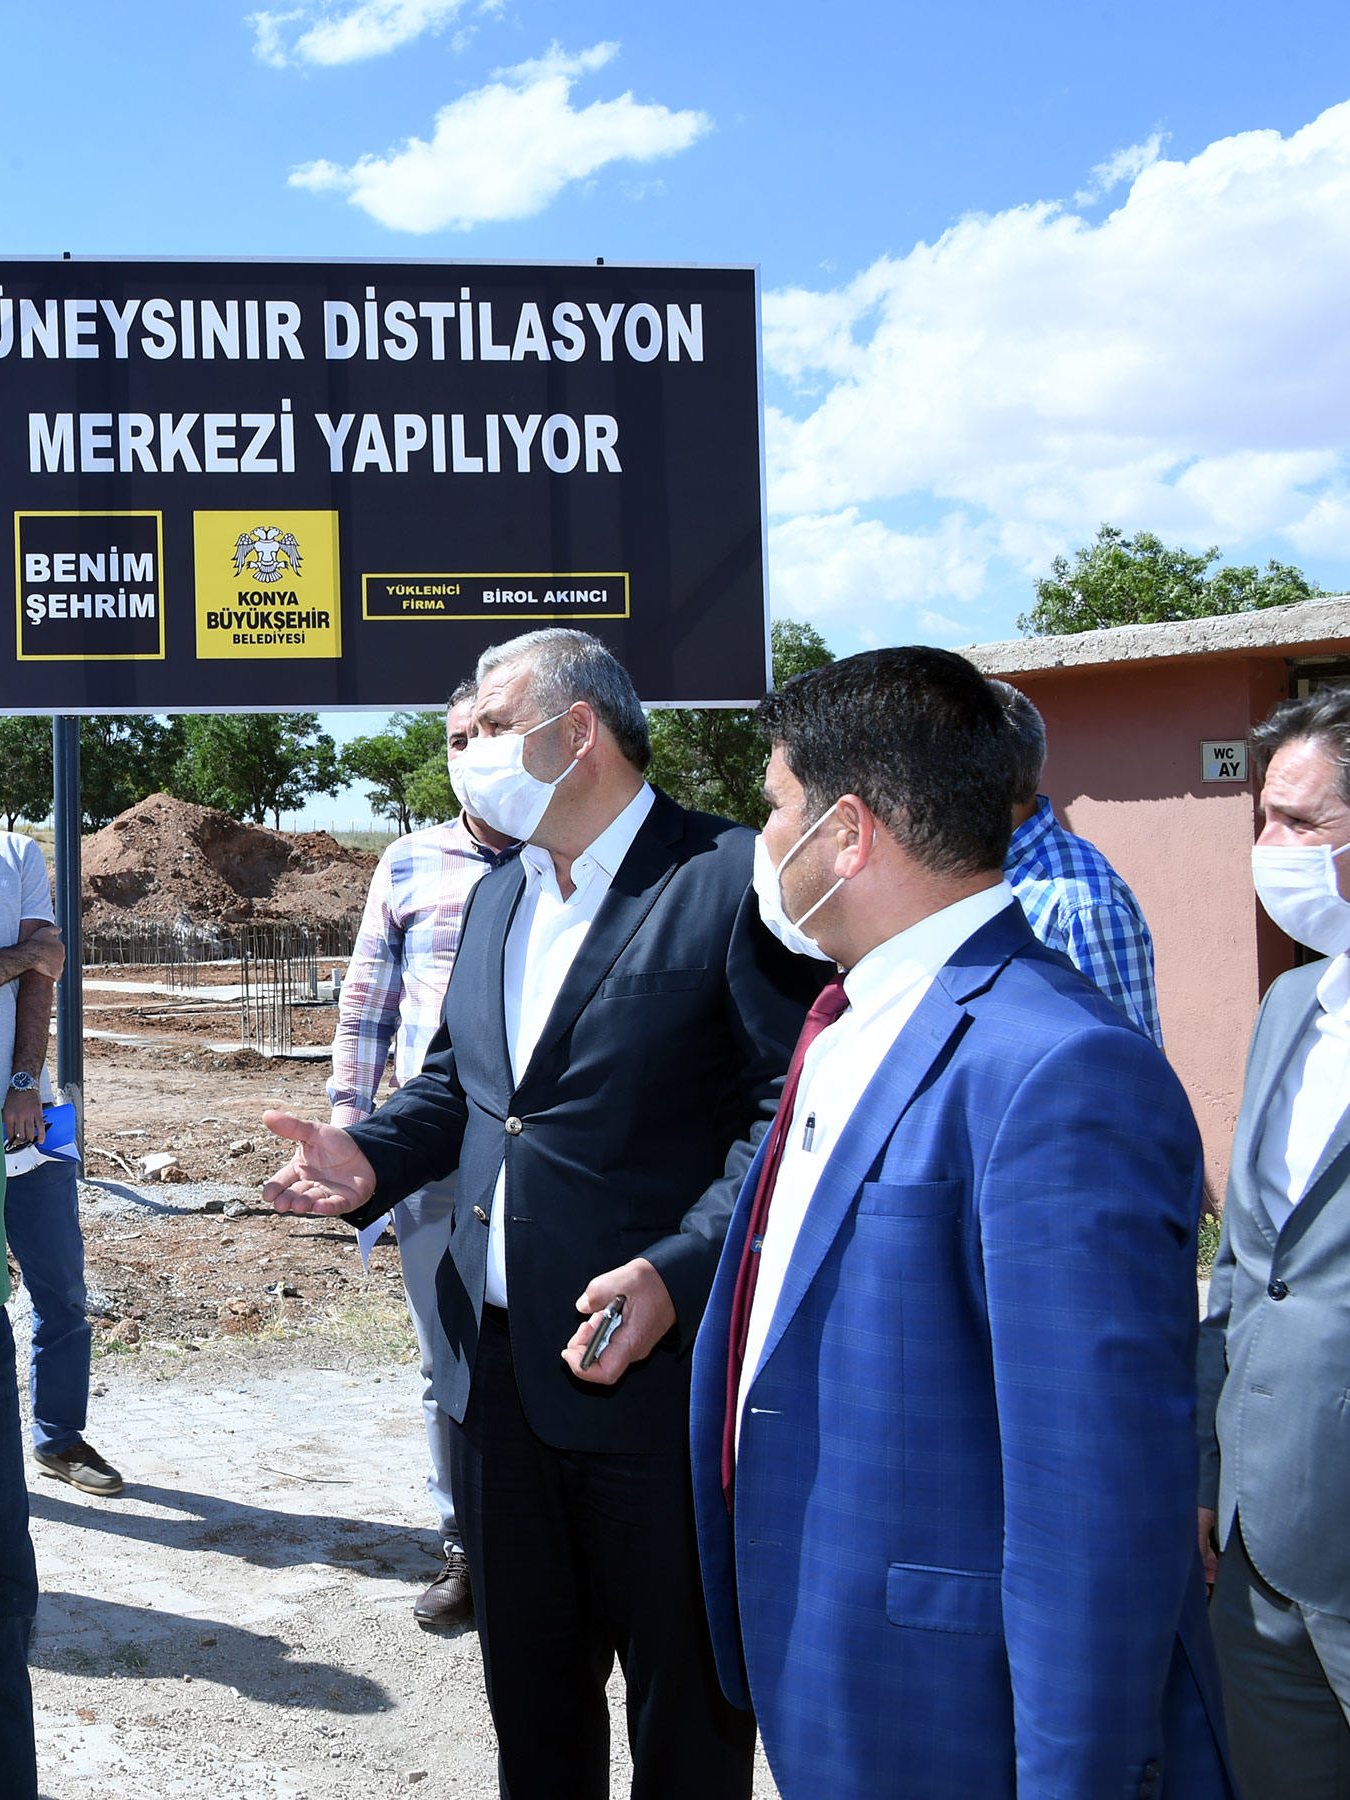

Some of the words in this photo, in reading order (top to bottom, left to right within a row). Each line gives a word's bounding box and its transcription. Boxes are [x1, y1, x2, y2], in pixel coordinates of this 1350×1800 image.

[323, 286, 704, 363] DİSTİLASYON
[28, 398, 296, 473] MERKEZİ
[314, 413, 623, 474] YAPILIYOR
[25, 546, 154, 583] BENİM
[385, 583, 461, 596] YÜKLENİCİ
[482, 587, 539, 604] BİROL
[543, 589, 608, 603] AKINCI
[237, 591, 299, 606] KONYA
[402, 598, 446, 610] FİRMA
[25, 589, 155, 626] ŞEHRİM
[206, 607, 331, 632] BÜYÜKŞEHİR
[232, 631, 306, 645] BELEDİYESİ
[1213, 747, 1235, 760] WC
